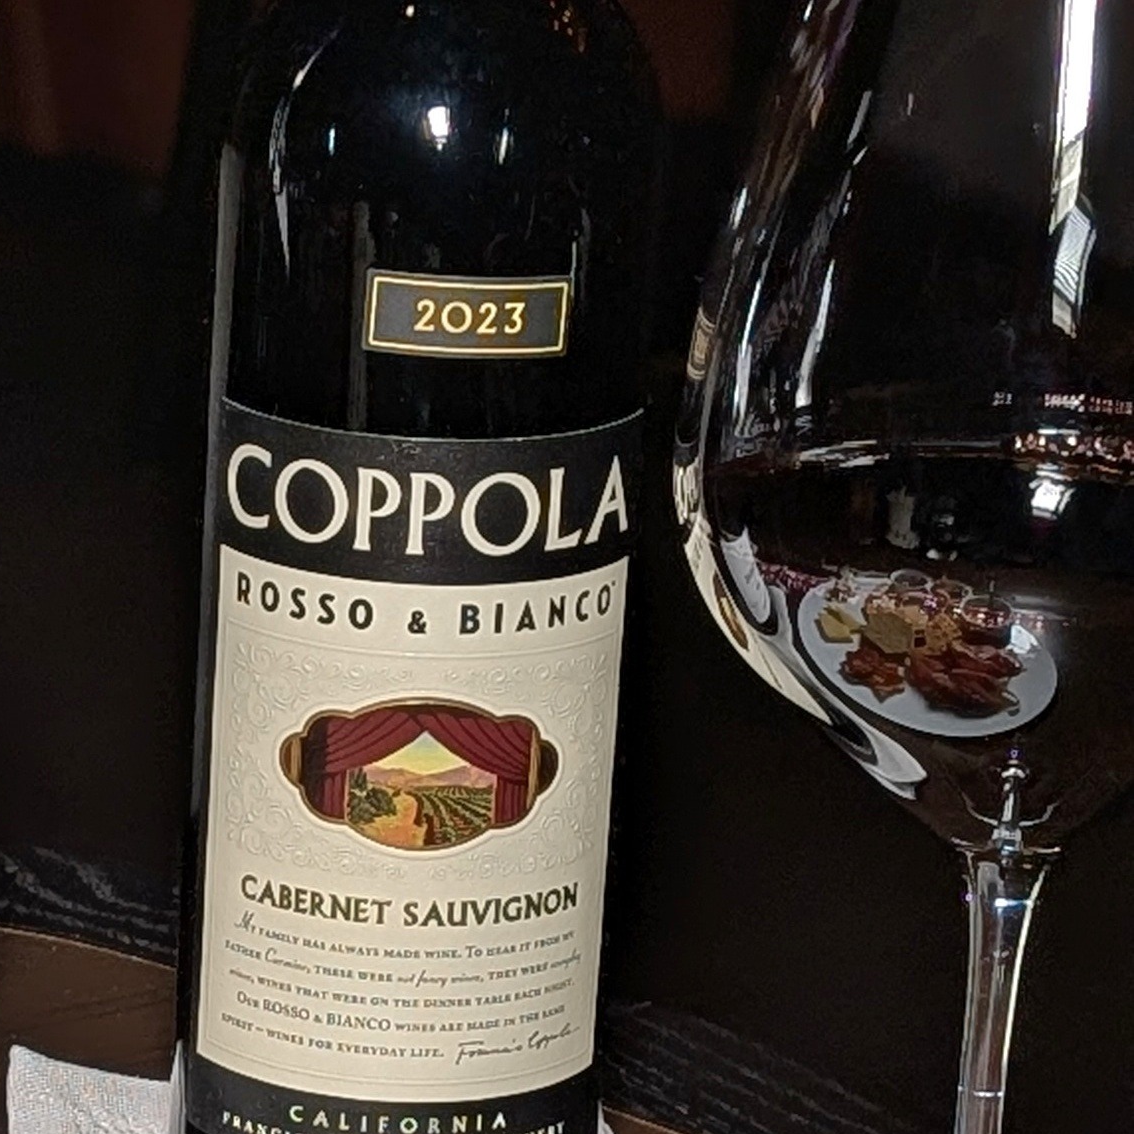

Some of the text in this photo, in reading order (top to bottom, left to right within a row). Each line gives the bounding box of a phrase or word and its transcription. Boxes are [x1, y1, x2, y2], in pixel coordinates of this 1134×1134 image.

[414, 299, 526, 335] 2023
[226, 443, 629, 557] COPPOLA
[237, 571, 612, 636] ROSSO & BIANCO
[241, 874, 579, 928] CABERNET SAUVIGNON
[259, 927, 299, 944] FAMILY
[303, 938, 326, 950] HAS
[329, 943, 379, 957] ALWAYS
[384, 949, 420, 959] MADE
[424, 949, 462, 959] WINE.
[486, 945, 516, 957] HEAR
[519, 941, 532, 952] IT
[257, 974, 292, 992] WINES
[296, 985, 329, 1000] THAT
[332, 992, 367, 1005] WERE
[370, 996, 388, 1006] ON
[394, 998, 419, 1008] THE
[423, 997, 472, 1008] DINNER
[475, 993, 511, 1005] TABLE
[514, 987, 542, 1001] EACH
[314, 964, 353, 979] THESE
[358, 971, 393, 982] WERE
[415, 969, 448, 988] fancy
[488, 968, 518, 980] THEY
[521, 960, 548, 976] WERE
[263, 998, 310, 1020] ROSSO
[313, 1014, 323, 1024] &
[326, 1012, 391, 1032] BIANCO
[395, 1022, 436, 1032] WINES
[439, 1022, 464, 1032] ARE
[467, 1018, 499, 1031] MADE
[503, 1017, 516, 1027] IN
[519, 1012, 539, 1024] THE
[221, 1012, 254, 1032] SPIRIT
[266, 1028, 304, 1045] WINES
[308, 1038, 333, 1050] FOR
[337, 1042, 407, 1058] EVERYDAY
[410, 1048, 445, 1058] LIFE.
